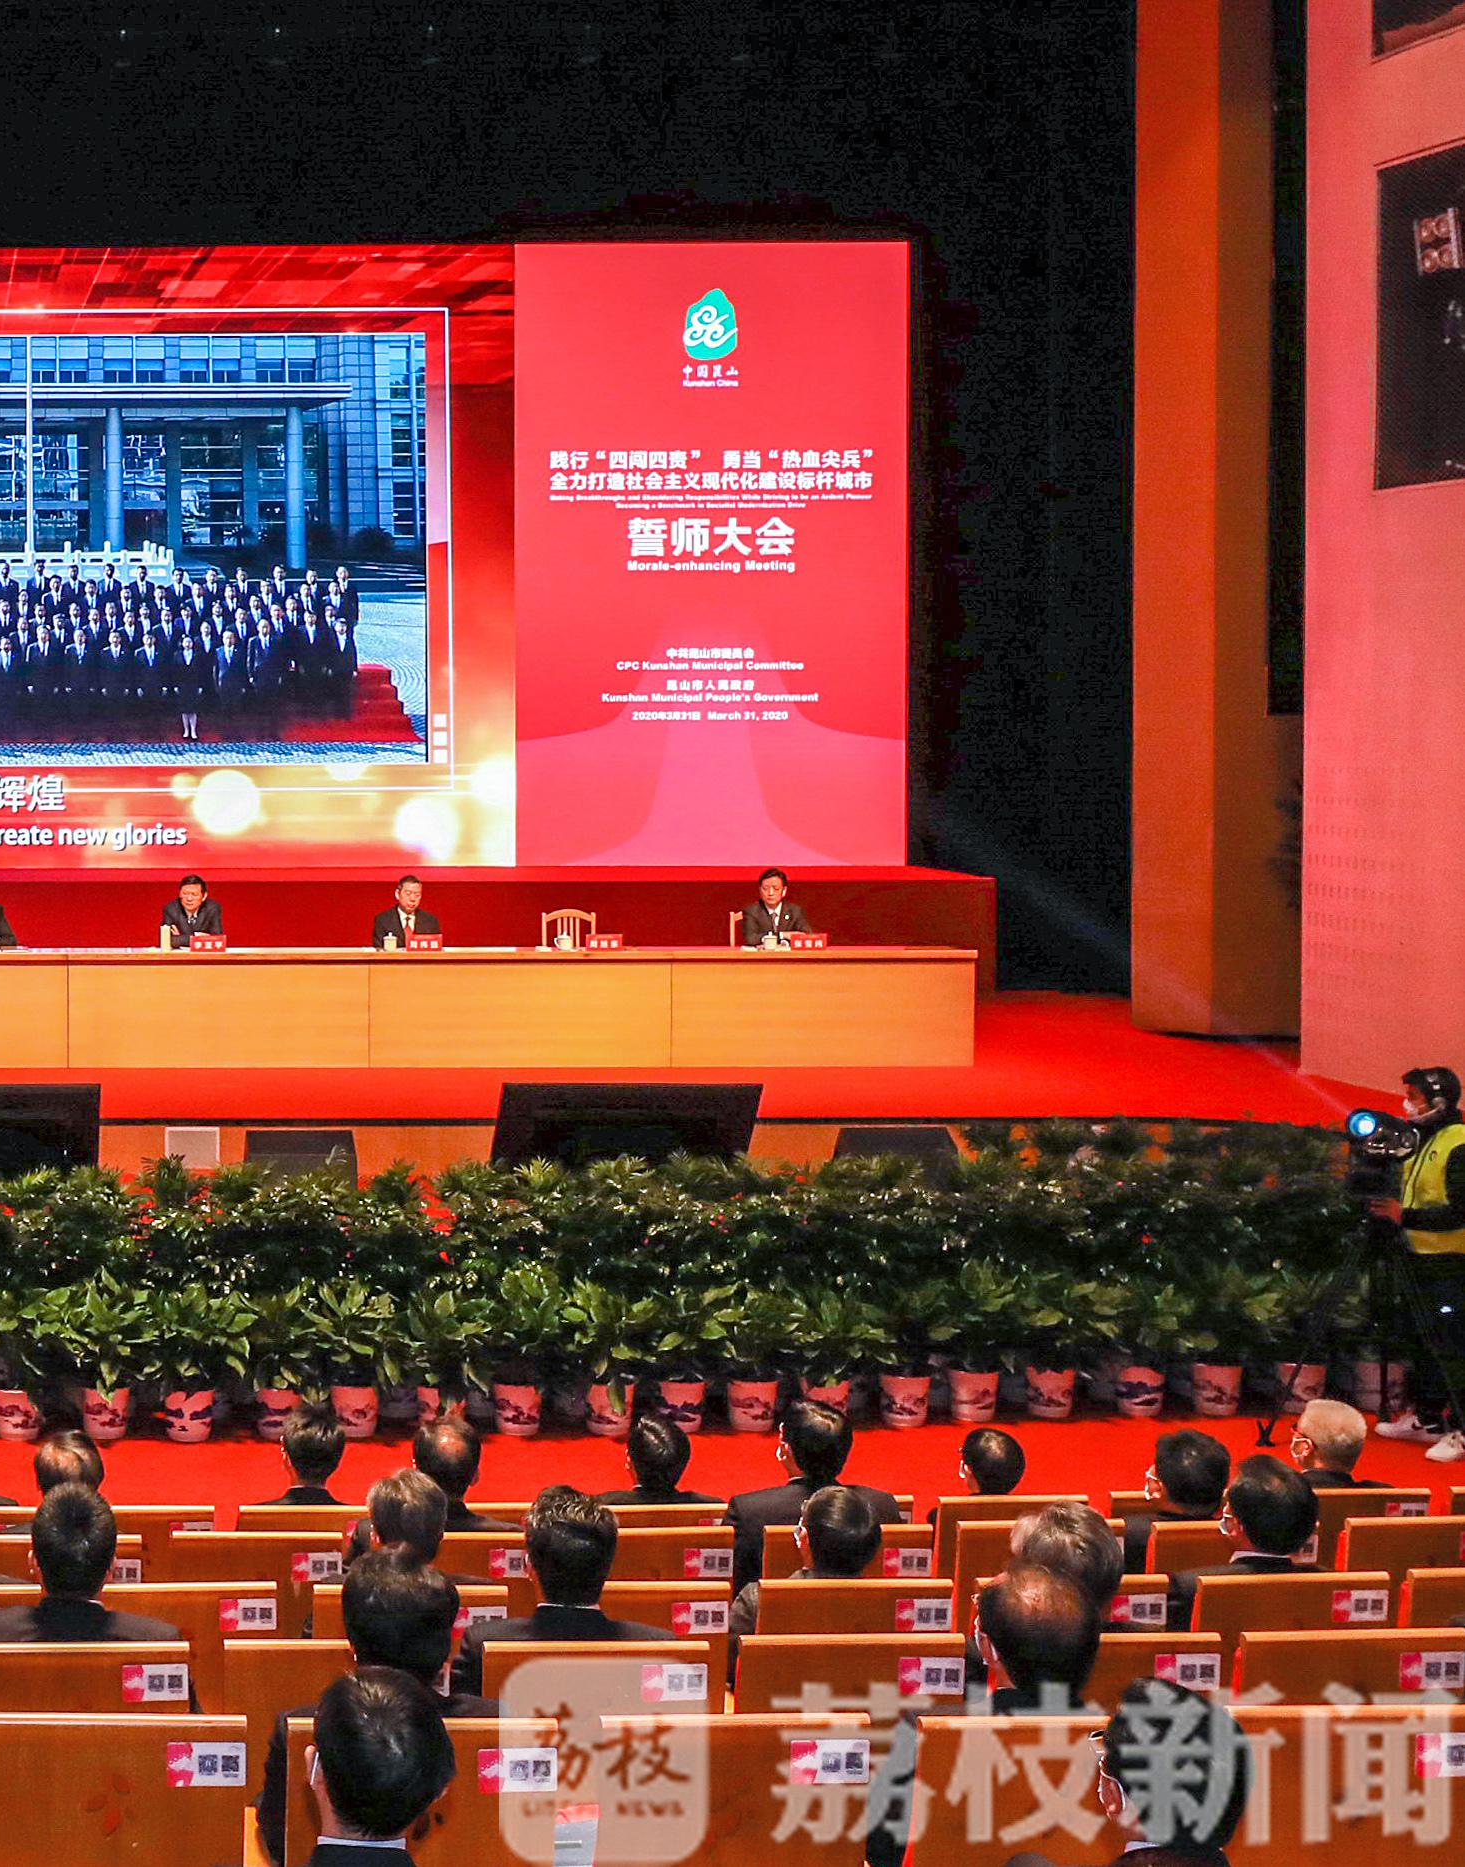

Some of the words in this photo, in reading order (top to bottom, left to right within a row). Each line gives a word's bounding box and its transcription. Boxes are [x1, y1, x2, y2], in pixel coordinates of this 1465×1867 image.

[549, 470, 873, 491] 全力打造社会主义现代化建设标杆城市
[627, 516, 796, 557] 誓师大会
[627, 559, 741, 574] Morale-enhancing
[744, 559, 796, 573] Meeting
[616, 661, 640, 671] CPC
[642, 660, 690, 671] Kunshan
[691, 660, 744, 672] Municipal
[745, 660, 805, 671] Committee
[601, 692, 649, 703] Kunshan
[650, 692, 704, 704] Municipal
[704, 691, 752, 704] People's
[752, 692, 819, 703] Government
[706, 710, 742, 721] March
[743, 710, 760, 721] 31,
[761, 710, 789, 721] 2020
[57, 829, 107, 846] new
[113, 823, 188, 851] glories
